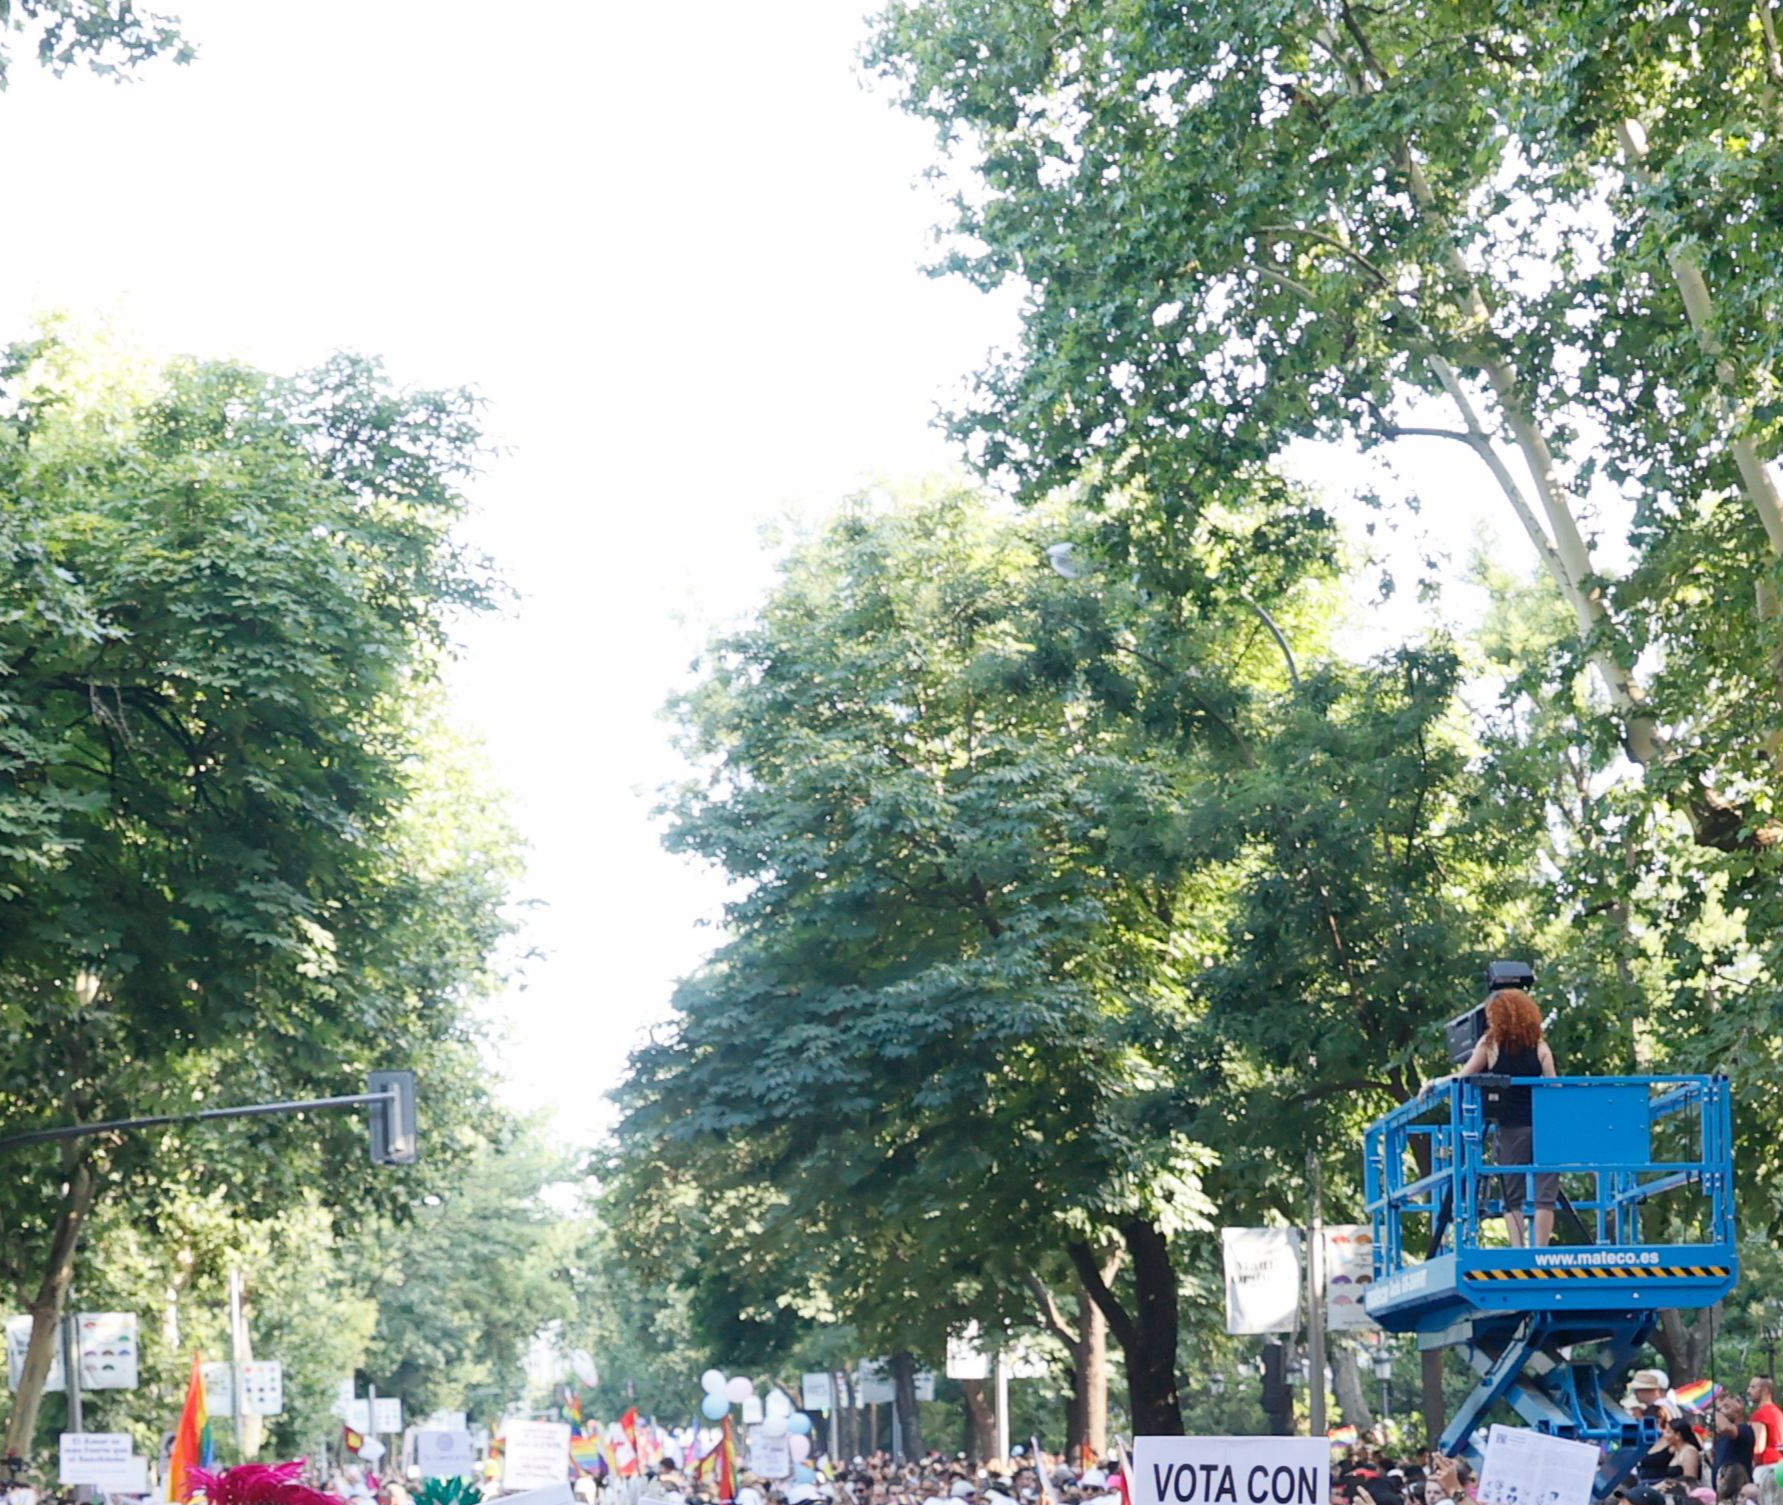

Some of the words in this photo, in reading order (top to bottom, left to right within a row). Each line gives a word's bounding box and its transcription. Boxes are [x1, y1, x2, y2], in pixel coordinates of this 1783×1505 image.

[1534, 1250, 1660, 1266] www.mateco.es
[1153, 1463, 1237, 1505] VOTA
[1247, 1464, 1318, 1505] CON
